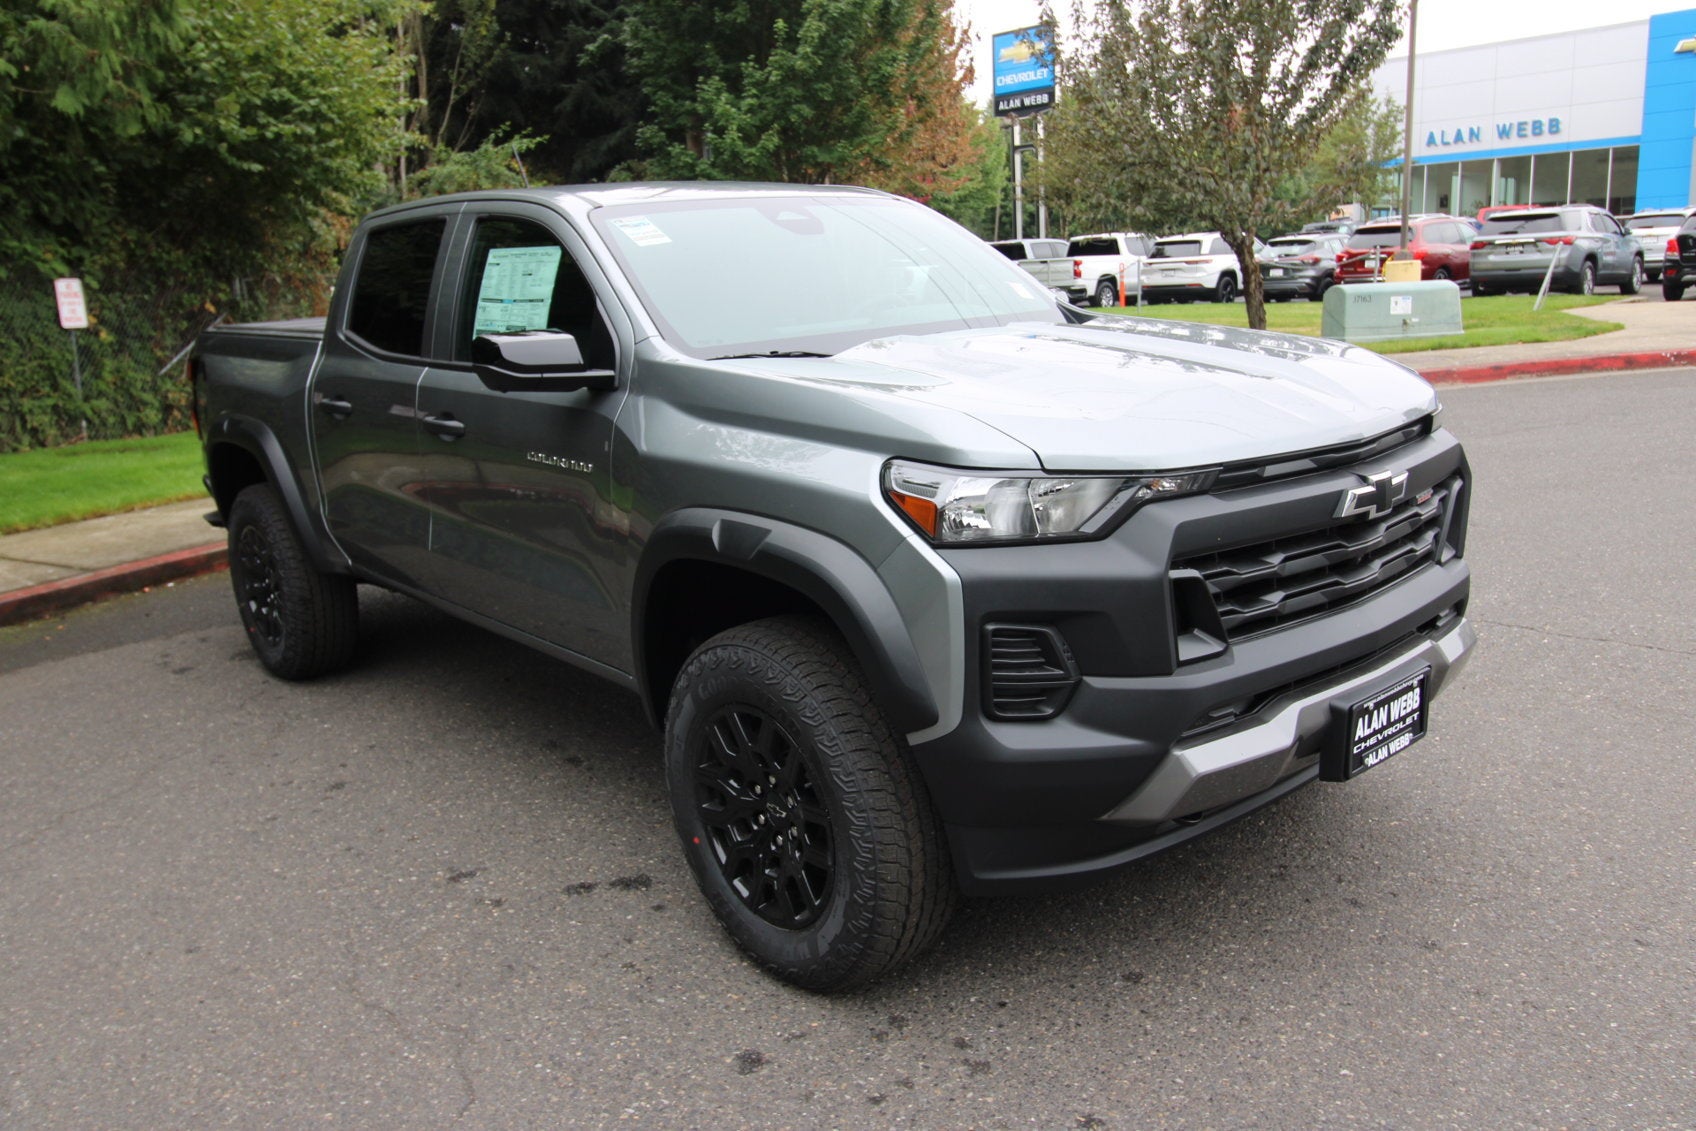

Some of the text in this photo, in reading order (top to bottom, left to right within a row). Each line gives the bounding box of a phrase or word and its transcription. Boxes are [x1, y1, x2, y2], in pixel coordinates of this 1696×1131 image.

[996, 68, 1048, 87] CHEVROLET
[998, 93, 1049, 111] ALAN WEBB
[1426, 117, 1561, 147] ALAN WEBB
[1354, 704, 1389, 741] ALAN
[1389, 687, 1420, 722] WEBB
[1353, 711, 1420, 754] CHEVROLET
[1367, 733, 1410, 767] ALAN WEBB
